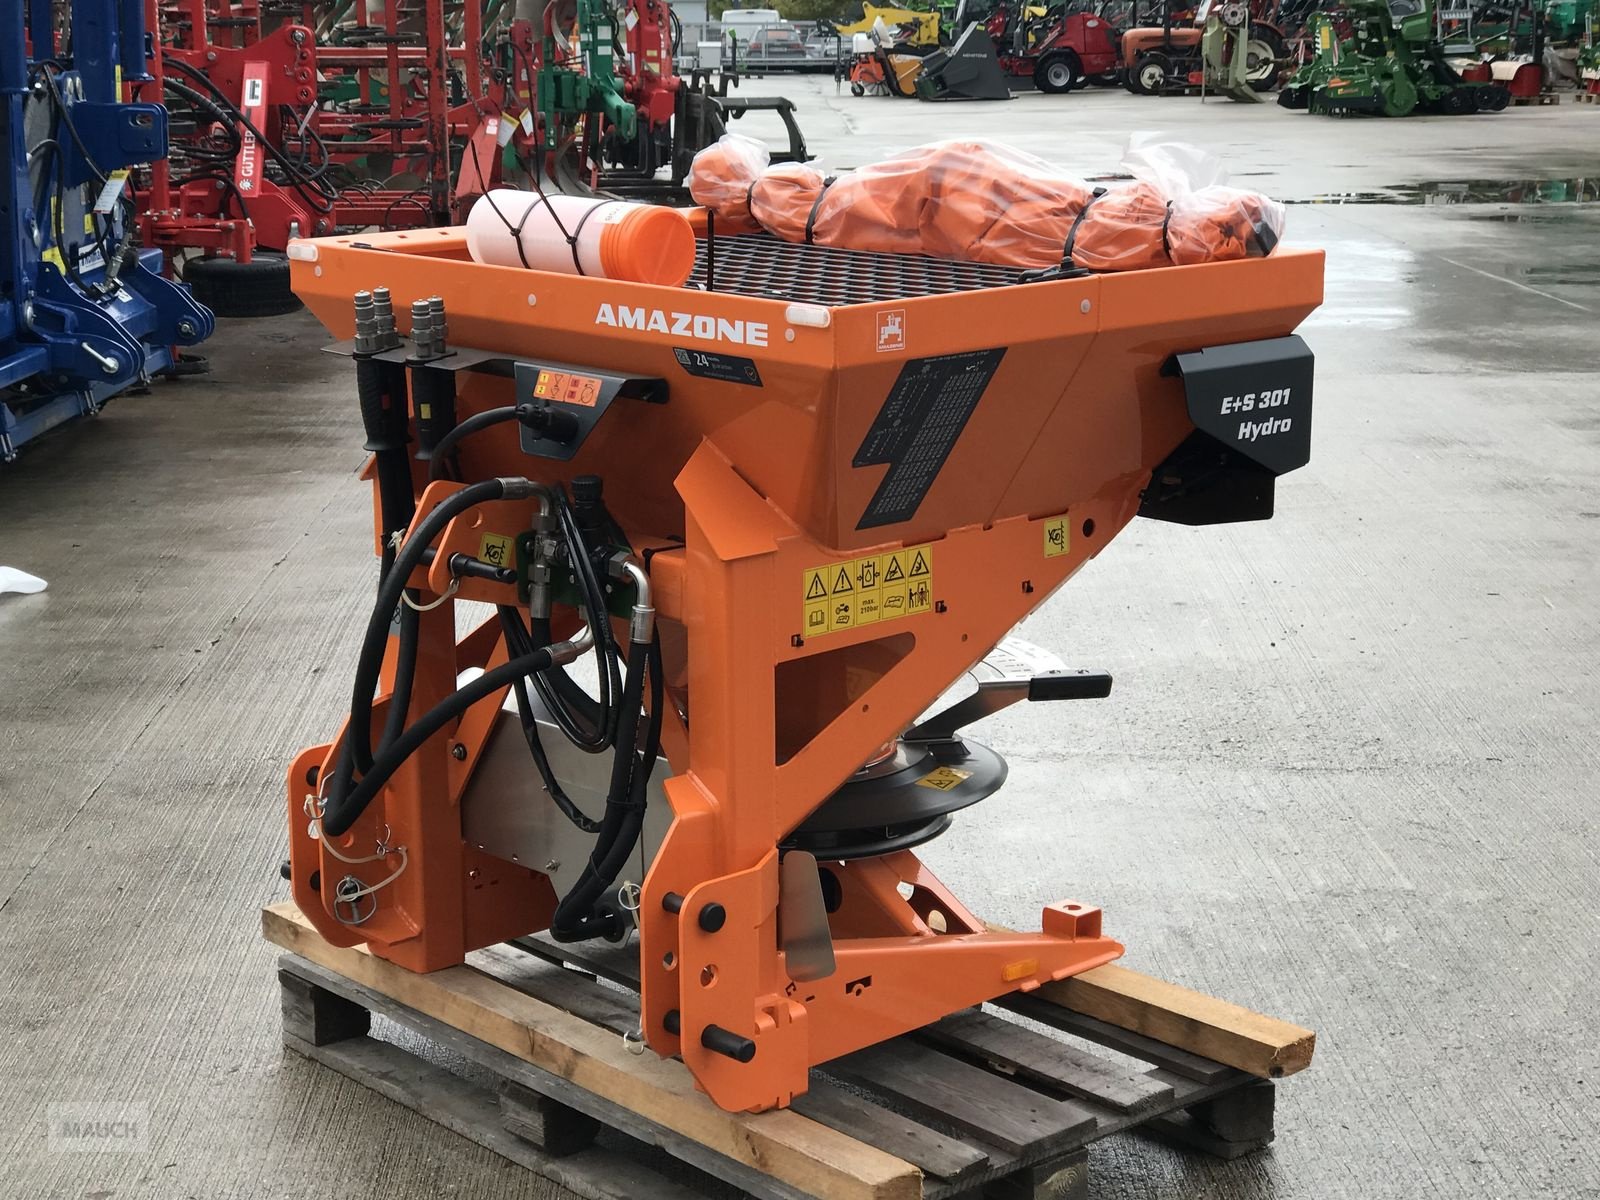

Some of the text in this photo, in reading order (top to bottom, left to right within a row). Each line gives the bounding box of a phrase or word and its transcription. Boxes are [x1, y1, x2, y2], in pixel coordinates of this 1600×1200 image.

[595, 303, 768, 347] AMAZONE
[694, 353, 709, 367] 24
[1220, 388, 1291, 415] E+S 301
[1238, 417, 1292, 442] Hydro
